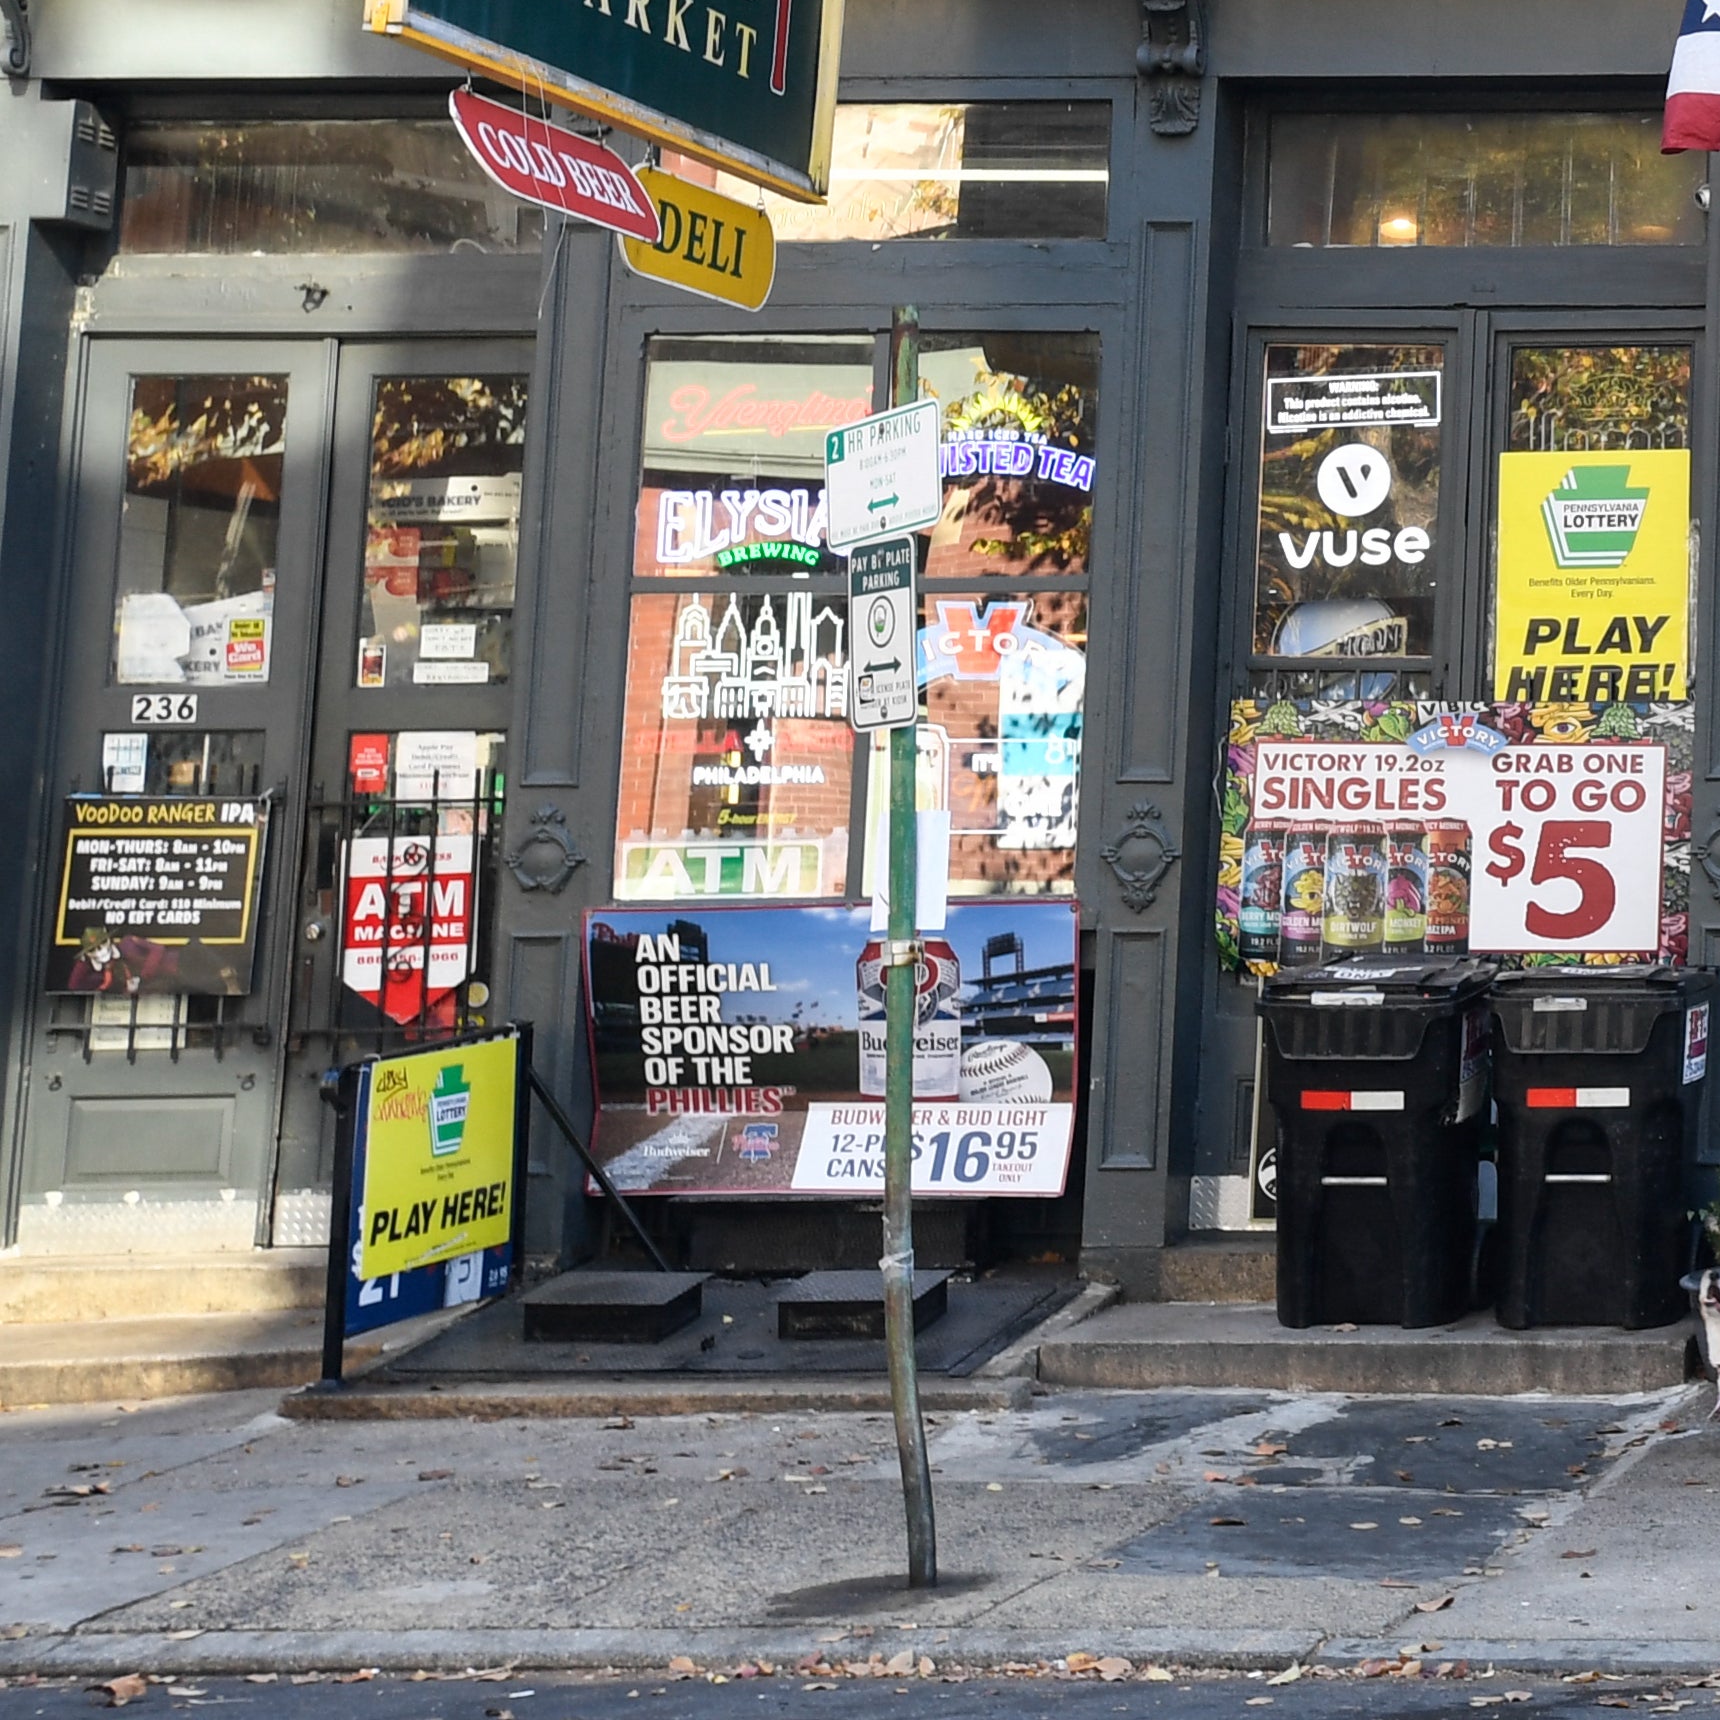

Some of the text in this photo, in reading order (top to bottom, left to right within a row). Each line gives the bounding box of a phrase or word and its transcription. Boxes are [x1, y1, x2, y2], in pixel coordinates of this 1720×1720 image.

[478, 120, 646, 218] COLD BEER
[654, 198, 746, 278] DELI
[831, 412, 921, 460] 2 HR PARKING
[988, 430, 1020, 442] ICED
[1024, 432, 1048, 445] TEA
[1038, 445, 1096, 492] TEA
[1563, 503, 1640, 513] PENNSYLVANIA
[1563, 514, 1639, 529] LOTTERY
[717, 541, 820, 568] BREWING
[852, 556, 867, 574] PAY
[886, 547, 910, 568] PLATE
[1278, 526, 1430, 569] vuse
[862, 571, 900, 592] PARKING
[1528, 576, 1564, 587] Benefits
[1565, 576, 1588, 587] Older
[1571, 588, 1595, 600] Every
[1523, 616, 1671, 655] PLAY
[229, 651, 262, 664] Card
[1505, 663, 1676, 703] HERE!
[135, 696, 194, 721] 236
[1417, 724, 1499, 750] VICTORY
[693, 765, 825, 786] PHILADELPHIA
[1263, 753, 1364, 773] VICTORY
[1492, 753, 1572, 774] GRAB
[1583, 753, 1644, 774] ONE
[1261, 778, 1647, 813] SINGLES TO GO
[147, 802, 216, 824] RANGER
[221, 802, 255, 823] IPA
[634, 847, 798, 894] ATM
[1485, 819, 1616, 940] $5
[353, 880, 465, 922] ATM
[105, 910, 201, 925] NO EBT CARDS
[635, 933, 680, 963] AN
[637, 963, 777, 994] OFFICIAL
[640, 995, 722, 1025] BEER
[641, 1025, 795, 1055] SPONSOR
[644, 1056, 753, 1086] OF THE
[436, 1105, 467, 1123] LOTTERY
[831, 1109, 1048, 1127] BUDWER & BUD LIGHT
[992, 1162, 1033, 1173] TAKEOUT
[370, 1180, 507, 1246] PLAY HERE!
